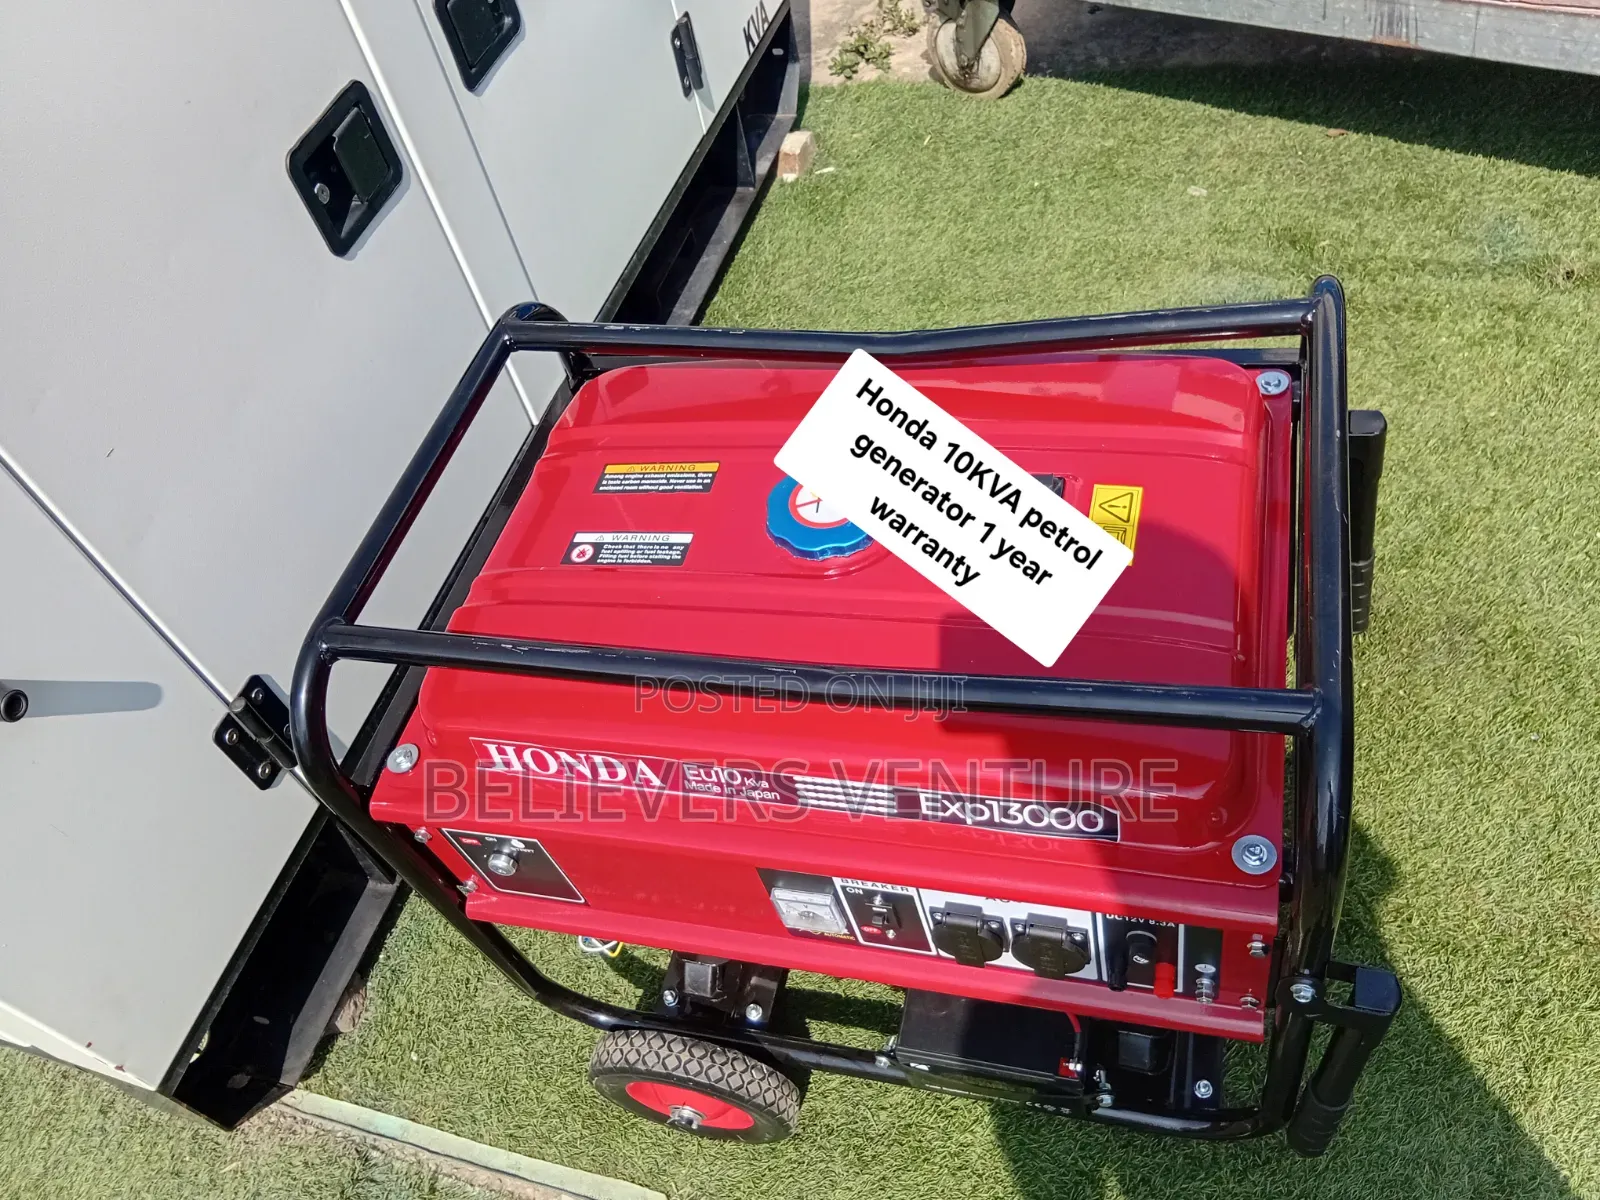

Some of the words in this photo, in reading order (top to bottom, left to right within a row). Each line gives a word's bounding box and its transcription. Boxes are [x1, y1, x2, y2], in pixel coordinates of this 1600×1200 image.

[640, 464, 696, 472] WARNING
[612, 534, 671, 542] WARNING
[482, 743, 666, 787] HONDA
[682, 763, 742, 785] Eu10
[683, 780, 722, 793] Made
[723, 784, 737, 795] in
[739, 786, 780, 800] Japan
[919, 792, 1104, 833] Exp13000
[840, 878, 910, 893] BREAKER
[846, 886, 864, 895] ON
[863, 925, 878, 933] OFF
